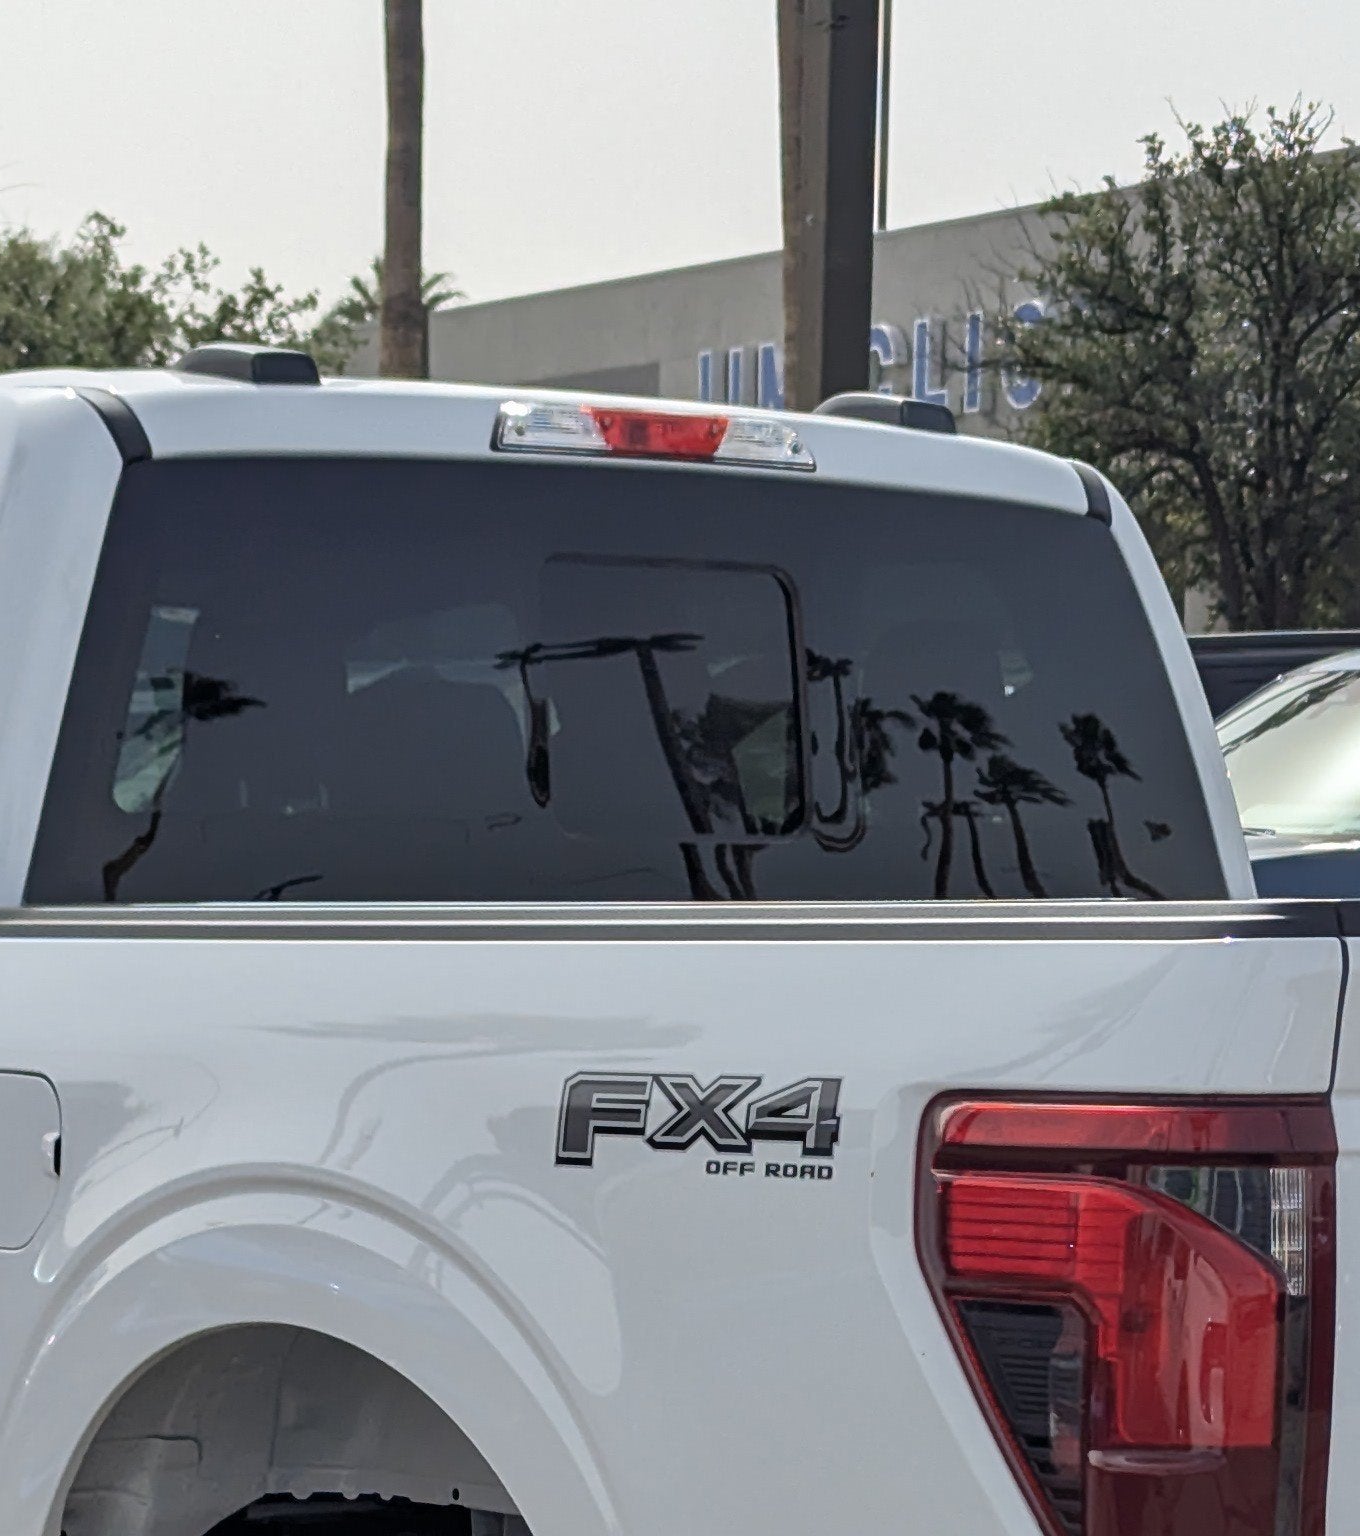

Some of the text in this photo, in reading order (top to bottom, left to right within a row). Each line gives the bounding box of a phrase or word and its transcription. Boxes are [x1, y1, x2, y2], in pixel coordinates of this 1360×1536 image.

[870, 299, 1045, 414] LIC
[554, 1070, 843, 1168] FX4
[705, 1160, 833, 1180] OFF ROAD
